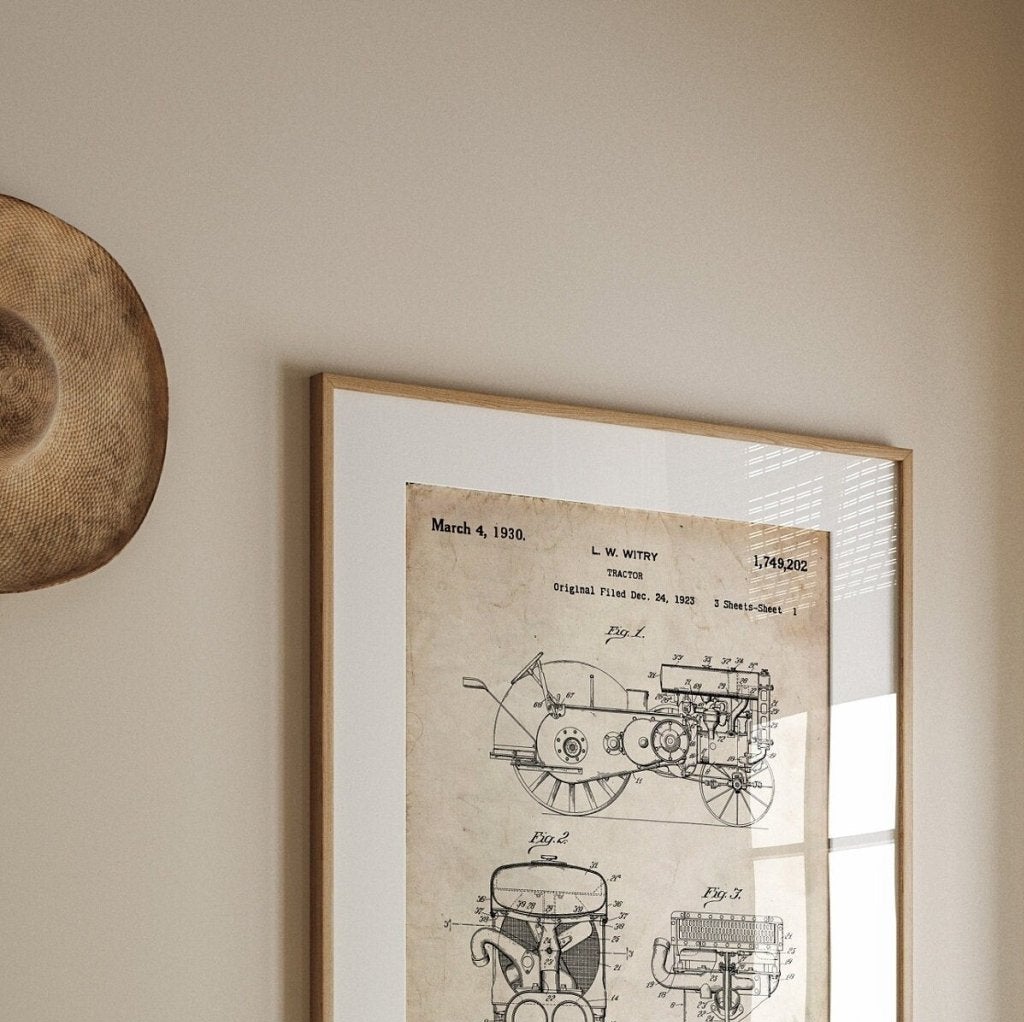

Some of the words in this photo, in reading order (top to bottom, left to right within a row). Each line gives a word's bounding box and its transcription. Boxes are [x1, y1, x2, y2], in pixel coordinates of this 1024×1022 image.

[432, 517, 471, 535] March
[475, 525, 487, 539] 4,
[493, 526, 526, 541] 1930.
[605, 547, 618, 558] W.
[623, 549, 658, 561] WITRY
[753, 555, 808, 572] 1,749,202
[607, 568, 643, 580] TRACTOR
[553, 583, 595, 595] Original
[600, 588, 626, 599] Filed
[631, 591, 650, 601] Dec.
[655, 593, 669, 604] 24,
[674, 595, 695, 606] 1923
[714, 599, 720, 608] 3
[723, 600, 783, 614] Sheets-Sheet
[792, 608, 798, 616] 1
